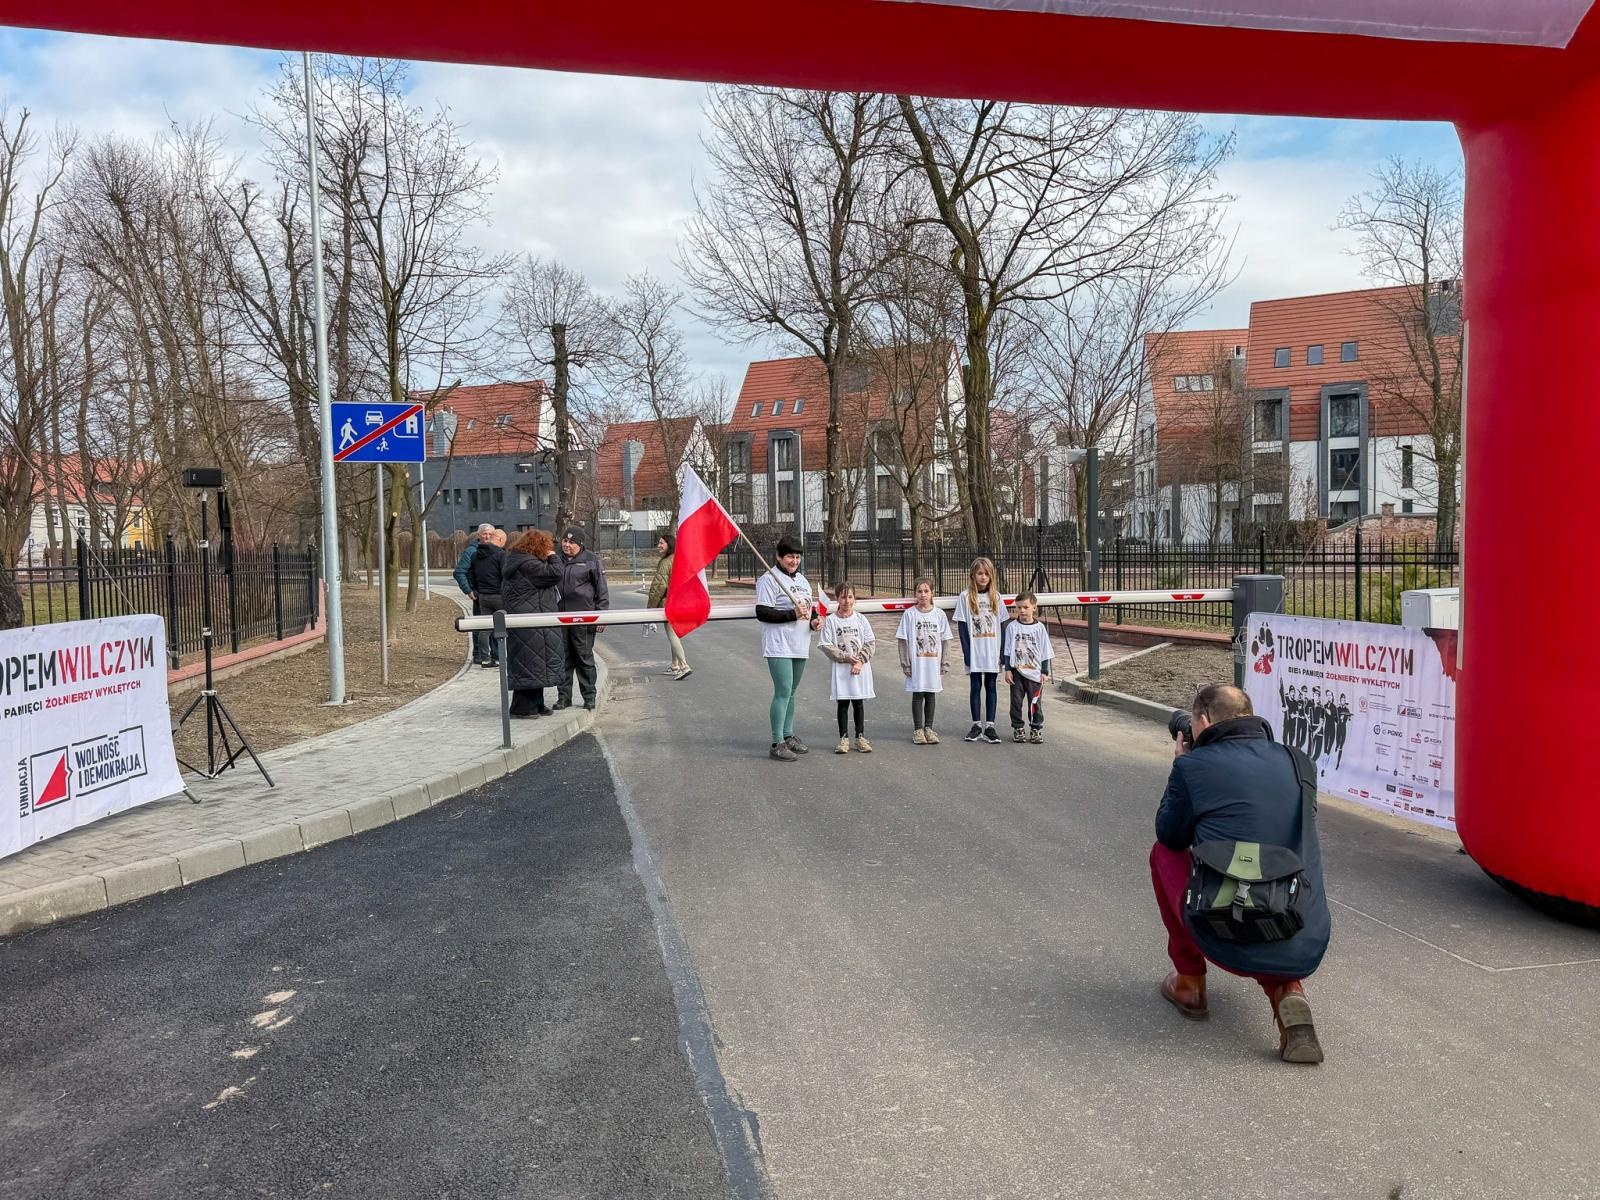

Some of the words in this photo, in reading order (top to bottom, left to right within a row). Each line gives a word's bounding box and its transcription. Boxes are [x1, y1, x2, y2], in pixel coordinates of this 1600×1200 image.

[1277, 635, 1414, 676] TROPEMWILCZYM
[4, 701, 42, 719] PAMIĘCI
[45, 689, 94, 709] ŻOŁNIERZY
[95, 680, 141, 699] WYKLĘTYCH
[1361, 677, 1401, 690] WYKLĘTYCH
[75, 736, 120, 769] WOLNOŚĆ
[78, 770, 83, 789] I
[84, 753, 142, 787] DEMOKRACJA
[18, 757, 30, 819] FUNDACJA
